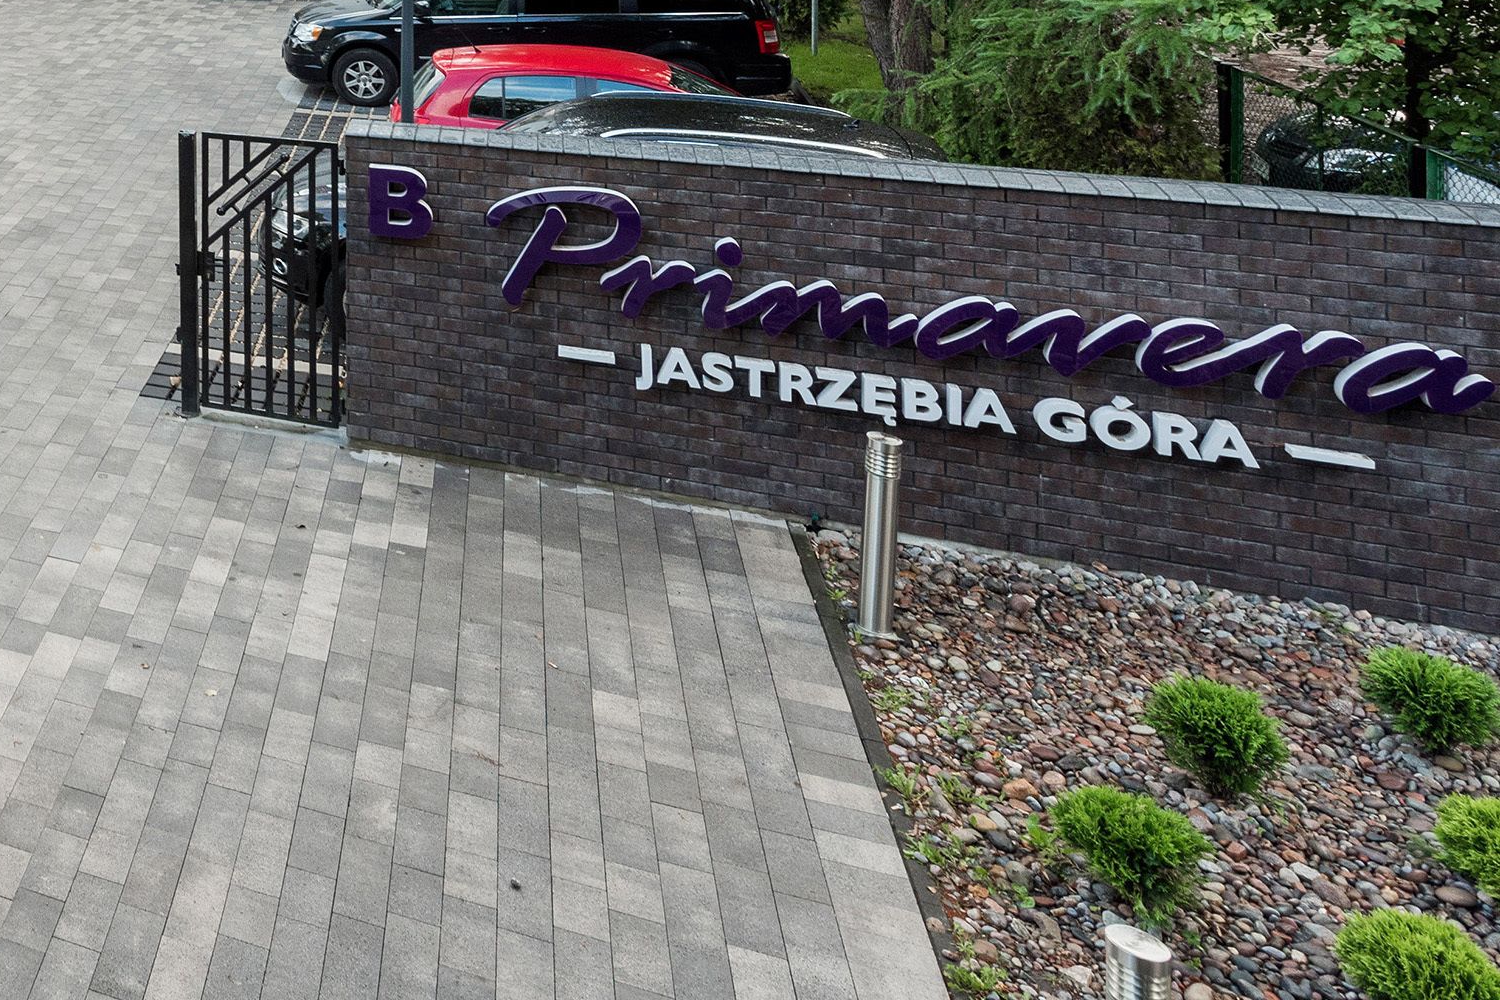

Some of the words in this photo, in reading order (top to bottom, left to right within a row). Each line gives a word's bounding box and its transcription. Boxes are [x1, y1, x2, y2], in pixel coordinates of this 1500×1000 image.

[368, 164, 434, 240] B
[486, 186, 1497, 415] Primavera
[635, 343, 1017, 435] JASTRZĘBIA
[1032, 395, 1261, 470] GÓRA
